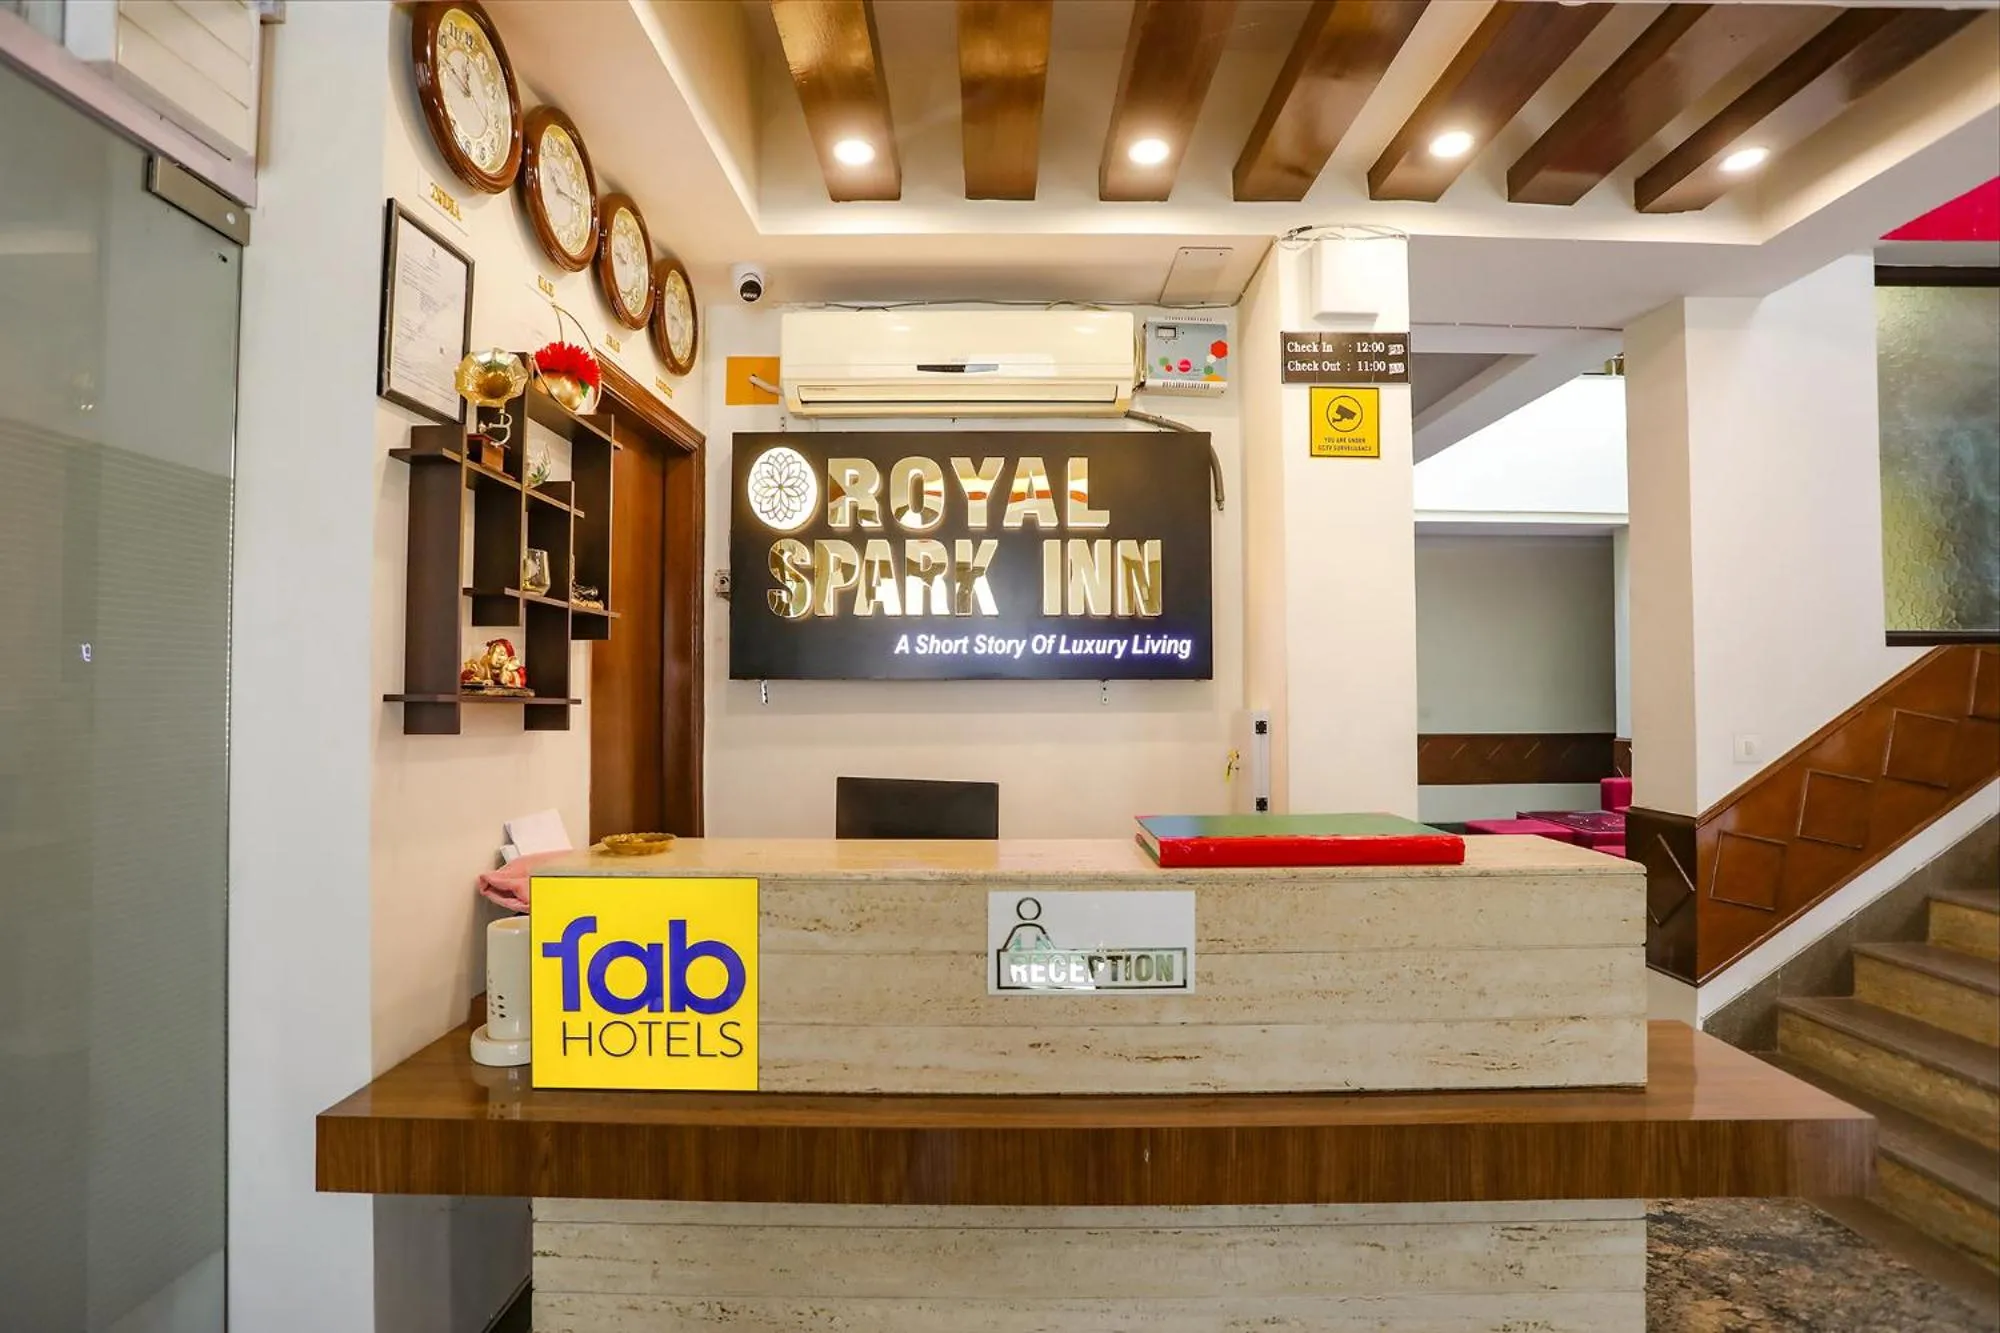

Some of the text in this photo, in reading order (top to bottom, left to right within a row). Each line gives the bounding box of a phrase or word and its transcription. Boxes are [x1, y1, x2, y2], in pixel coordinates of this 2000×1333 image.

[1287, 342, 1319, 353] Check
[1321, 342, 1333, 353] In
[1356, 342, 1385, 353] 12:00
[1287, 361, 1319, 372] Check
[1321, 361, 1341, 372] Out
[1357, 361, 1386, 372] 11:00
[827, 456, 1110, 529] ROYAL
[767, 538, 1163, 617] SPARK INN
[894, 634, 1192, 659] A Short Story Of Luxury Living
[542, 916, 746, 1015] fab
[1009, 953, 1174, 984] RECEPTION
[563, 1021, 743, 1057] HOTELS
